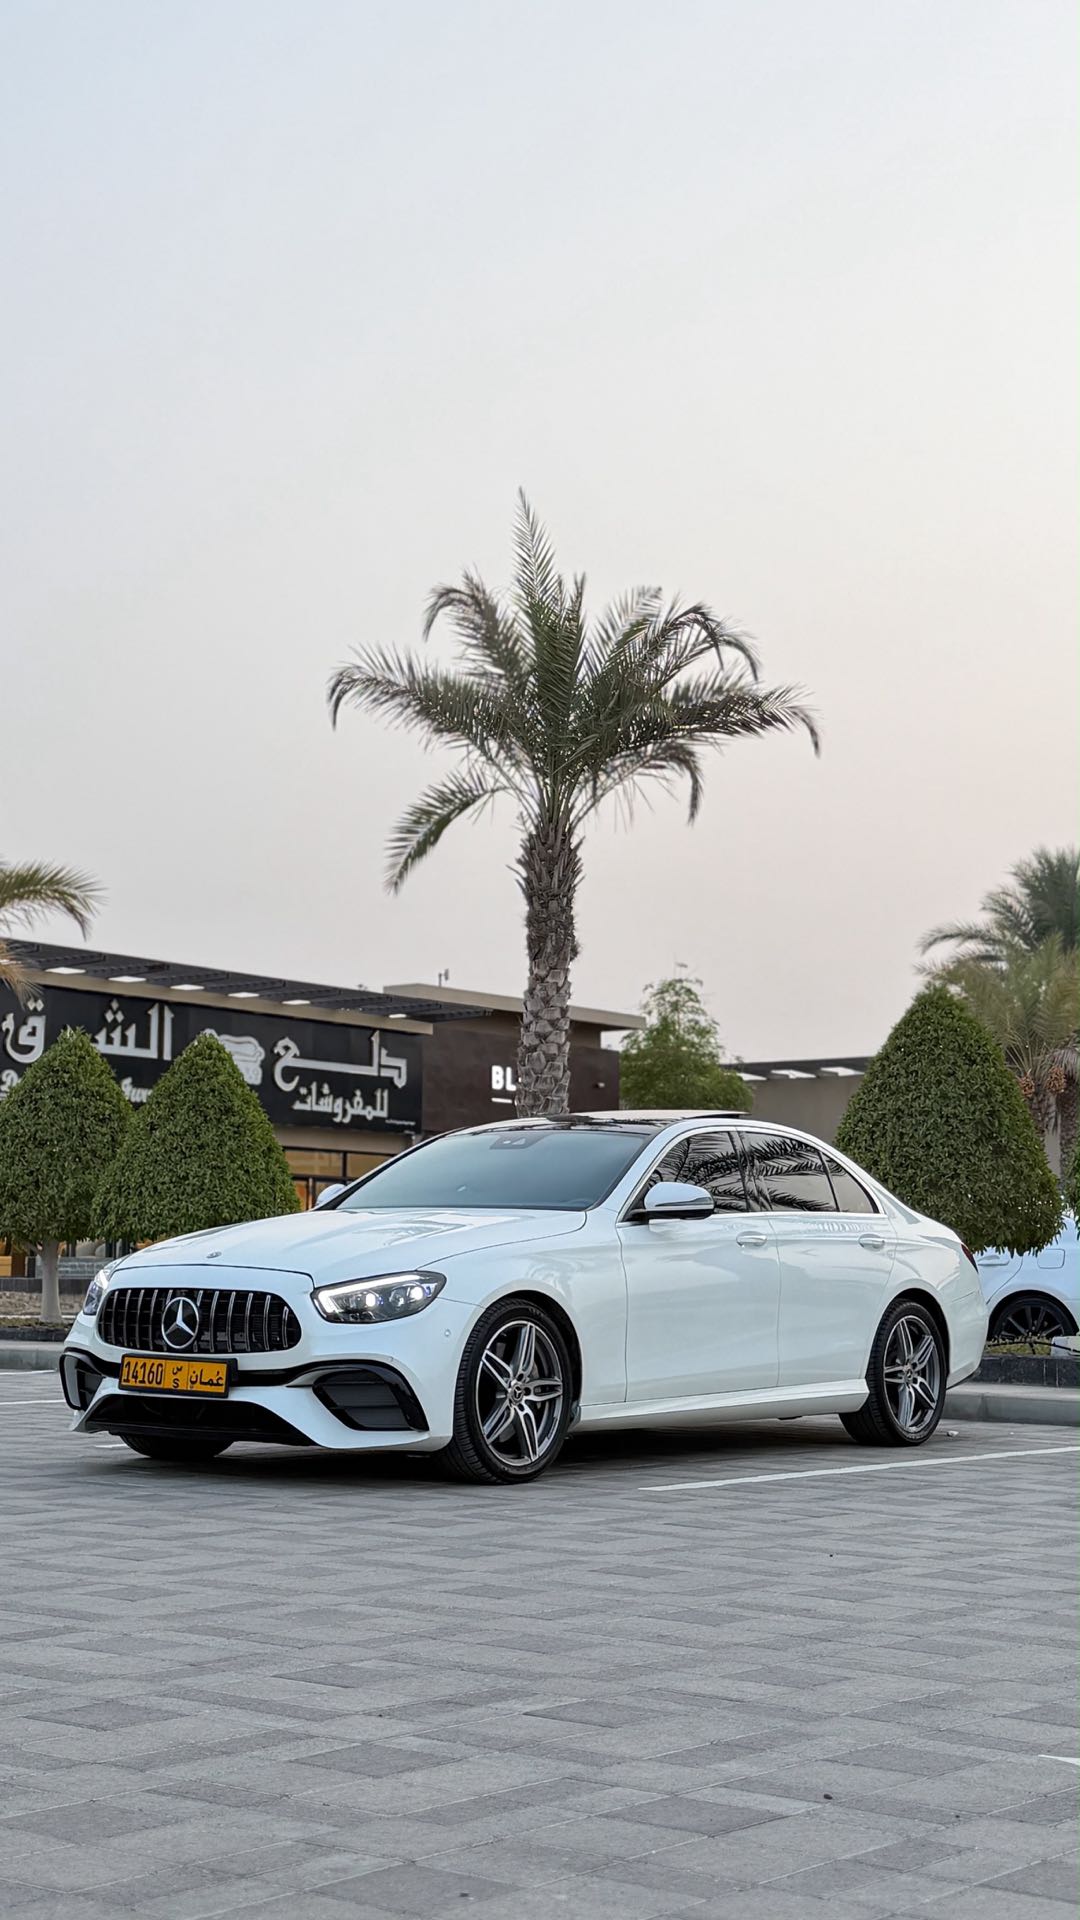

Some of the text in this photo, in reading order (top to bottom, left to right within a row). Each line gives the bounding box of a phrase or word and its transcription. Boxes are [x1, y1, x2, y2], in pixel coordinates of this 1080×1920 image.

[2, 999, 174, 1064] الشق
[292, 1081, 389, 1123] للمفروشات
[123, 1361, 163, 1385] 14160
[172, 1366, 182, 1375] س
[172, 1378, 180, 1388] S
